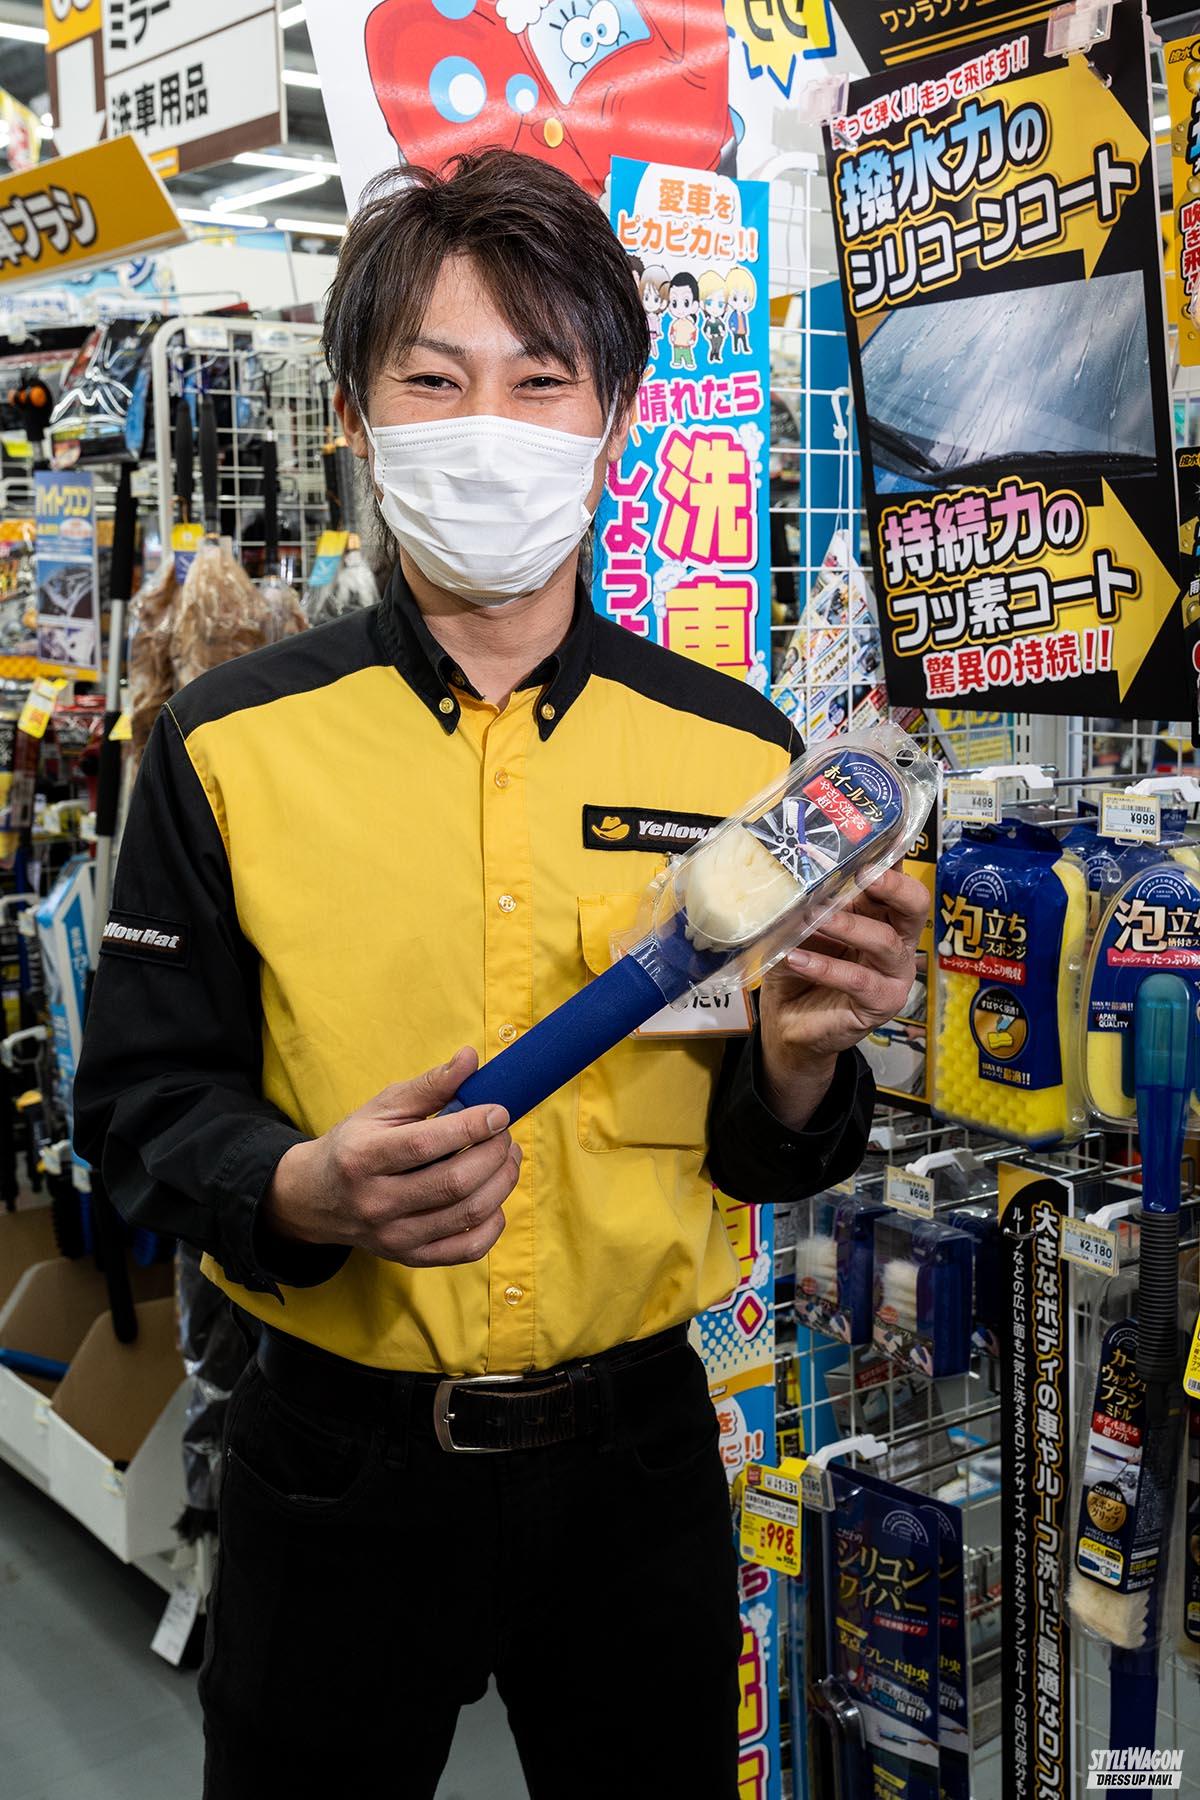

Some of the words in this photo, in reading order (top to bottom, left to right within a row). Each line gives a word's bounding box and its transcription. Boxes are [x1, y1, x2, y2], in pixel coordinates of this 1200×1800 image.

[112, 62, 208, 136] 洗車用品
[660, 178, 732, 214] 愛車を
[841, 105, 1043, 238] 撥水力の
[619, 214, 758, 260] ピカピカに!!
[851, 150, 1132, 309] シリコーンコート
[639, 375, 762, 424] 晴れたら
[605, 459, 649, 638] しょう
[659, 430, 754, 687] 洗車
[885, 486, 1080, 585] 持続力の
[893, 553, 1133, 650] フッ素コート
[926, 630, 1111, 696] 驚異の持続!!
[816, 795, 849, 830] 超ソフト
[819, 779, 867, 831] やさしく洗える
[824, 765, 885, 823] ホイールブラシ
[1131, 812, 1156, 826] ¥998
[940, 892, 1027, 959] 泡立ち
[985, 940, 1027, 960] スポンジ
[1080, 1239, 1113, 1259] ¥2,180
[767, 1522, 796, 1556] 998
[837, 1539, 932, 1589] シリコン
[838, 1572, 928, 1613] ワイパー
